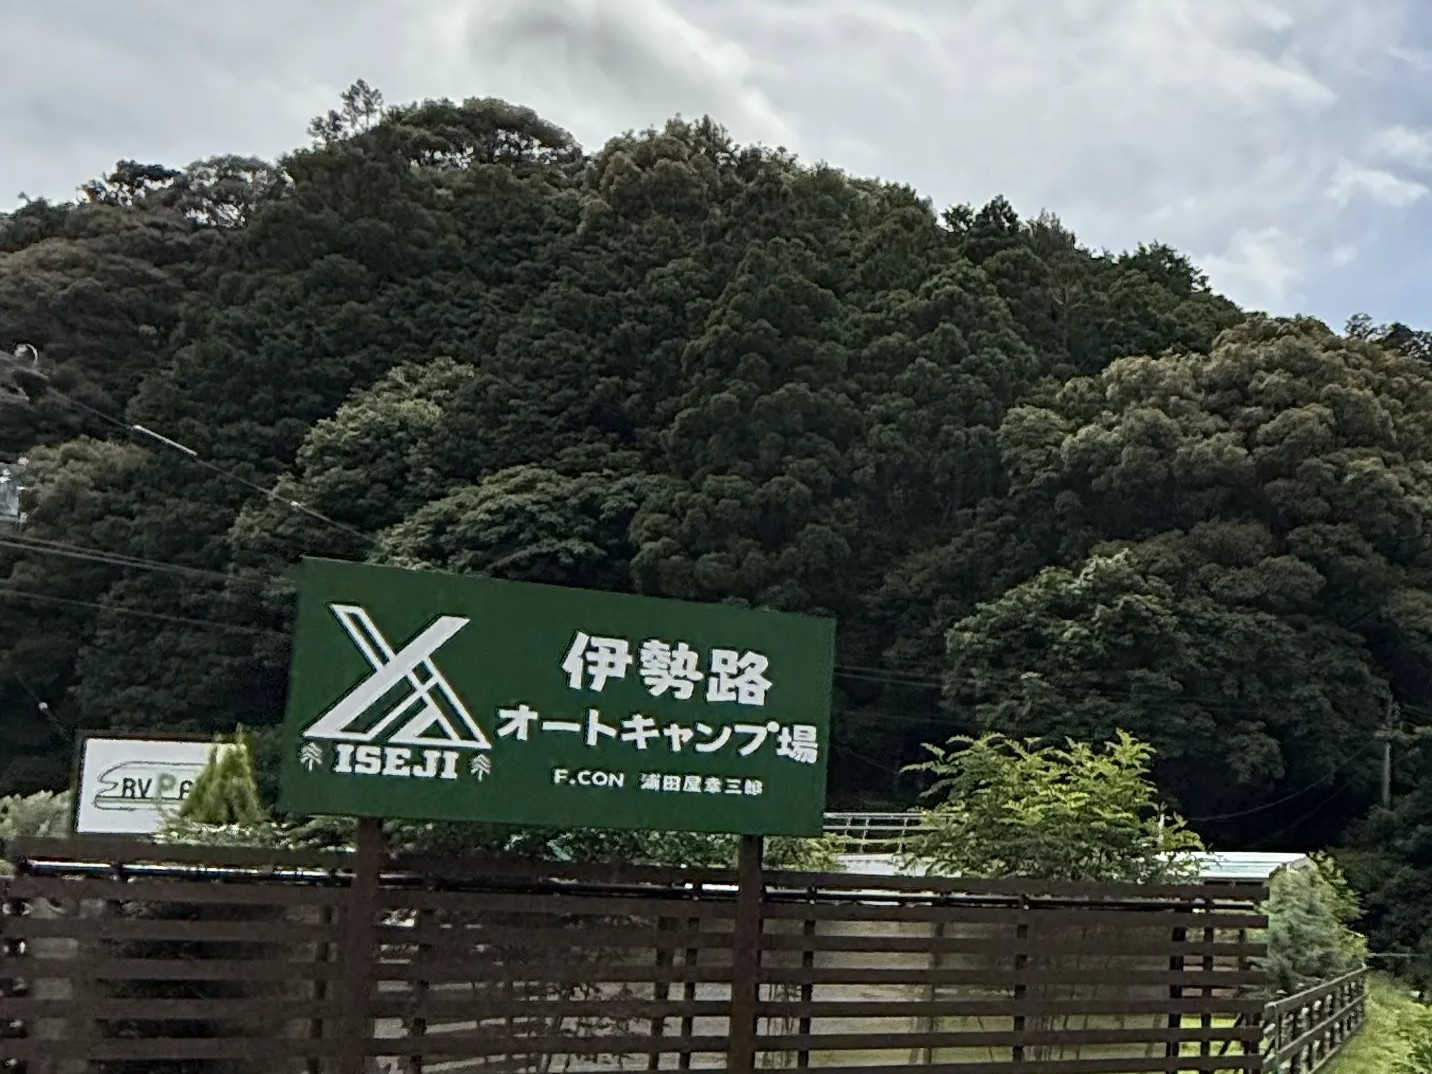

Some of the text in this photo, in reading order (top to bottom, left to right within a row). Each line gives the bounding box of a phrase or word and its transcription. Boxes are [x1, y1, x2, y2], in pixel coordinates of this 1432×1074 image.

[562, 631, 773, 706] 伊勢路
[497, 704, 819, 764] オートキャンプ場
[334, 744, 460, 781] ISEJI
[553, 768, 625, 788] F.CON
